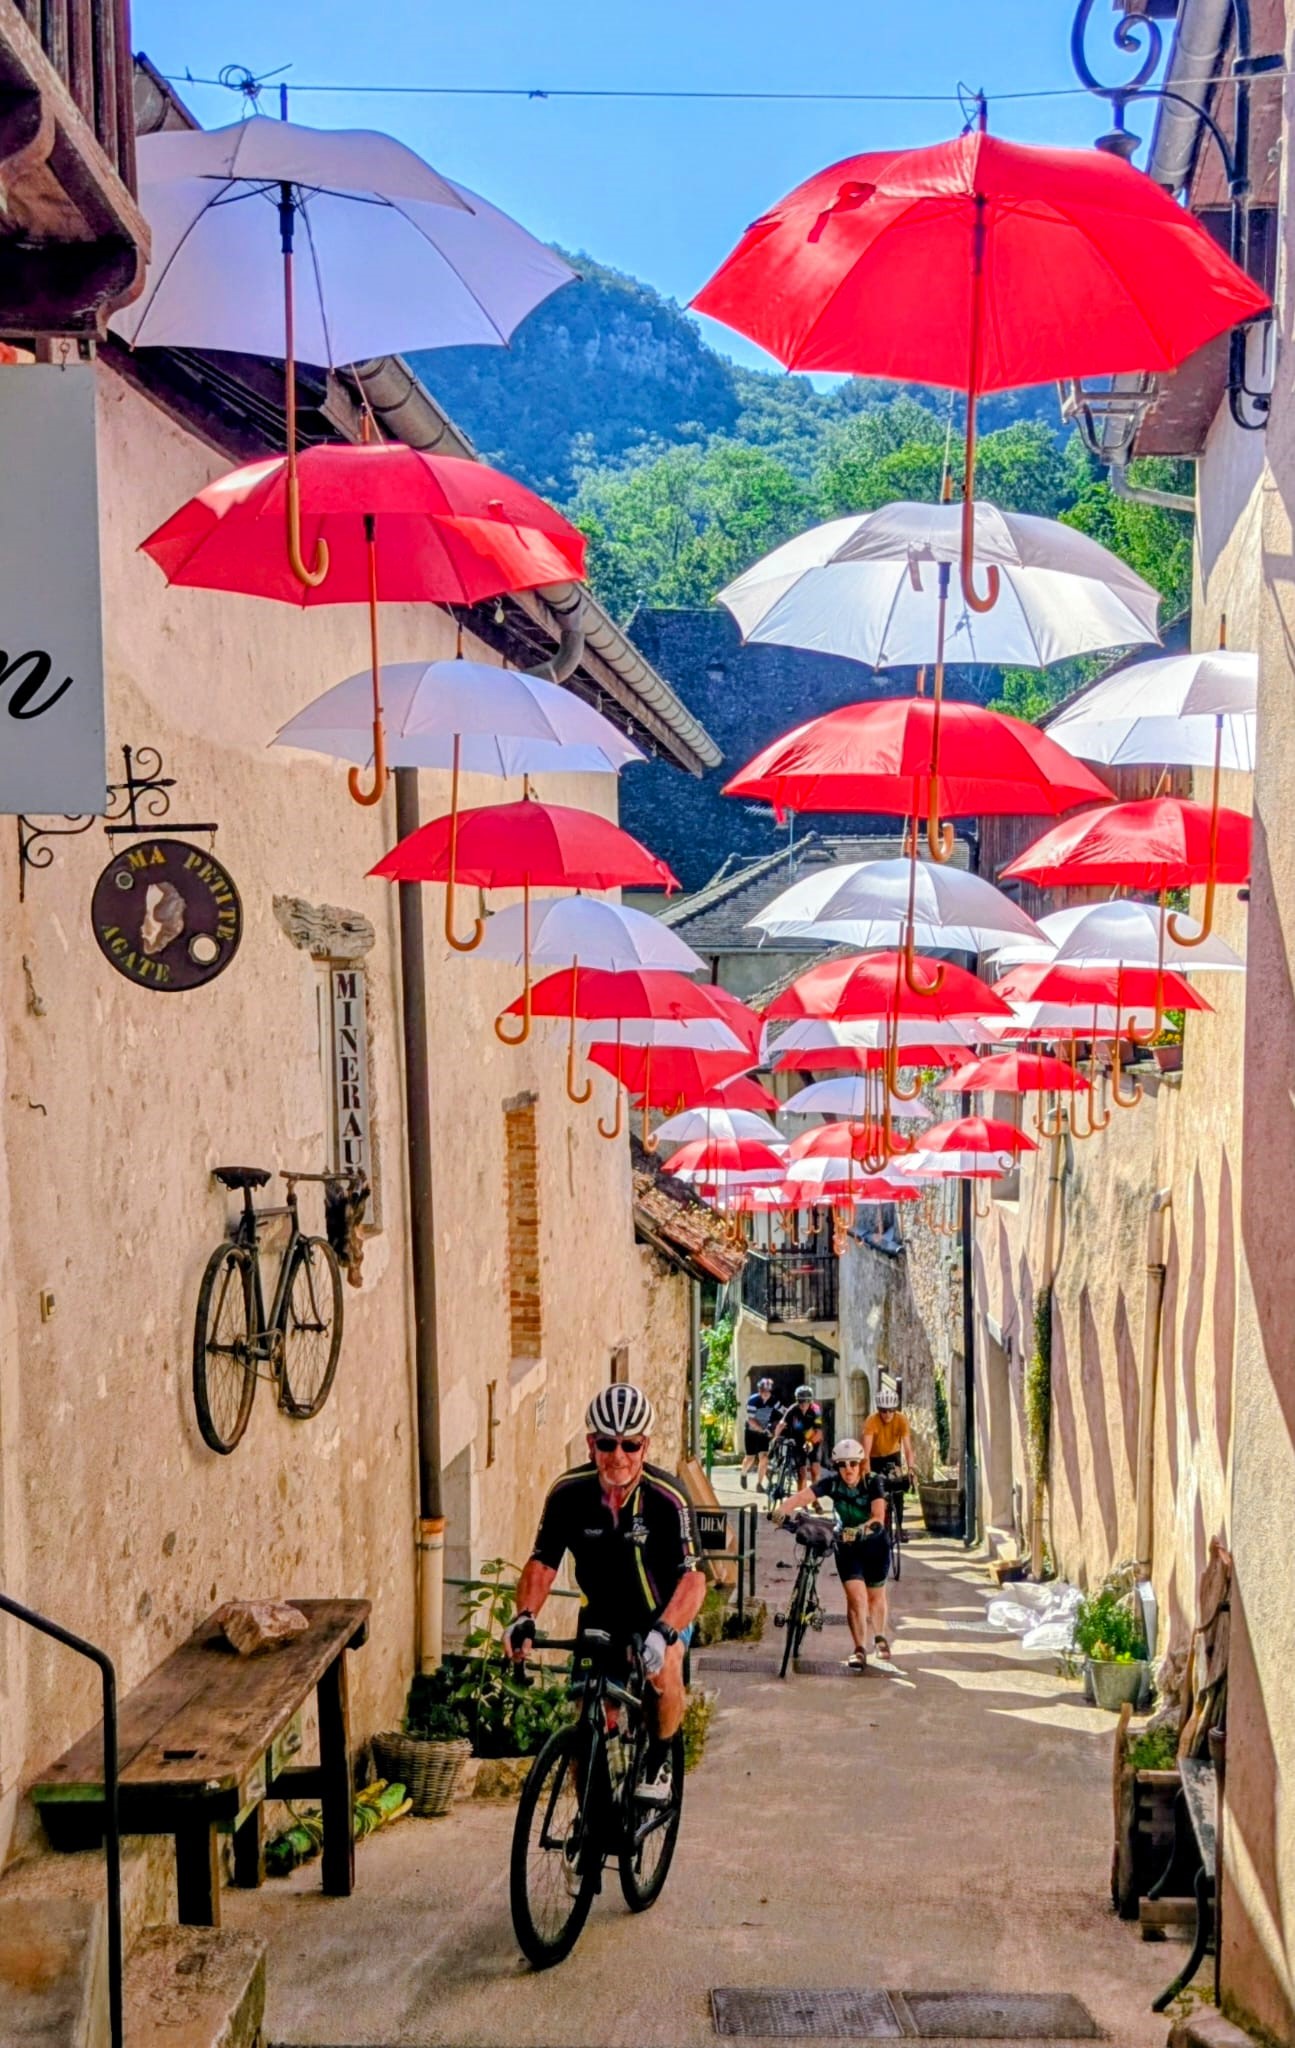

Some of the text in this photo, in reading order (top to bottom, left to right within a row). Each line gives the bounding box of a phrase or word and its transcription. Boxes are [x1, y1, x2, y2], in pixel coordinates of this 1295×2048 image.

[127, 846, 236, 941] MA PETITE
[102, 926, 172, 983] AGATE
